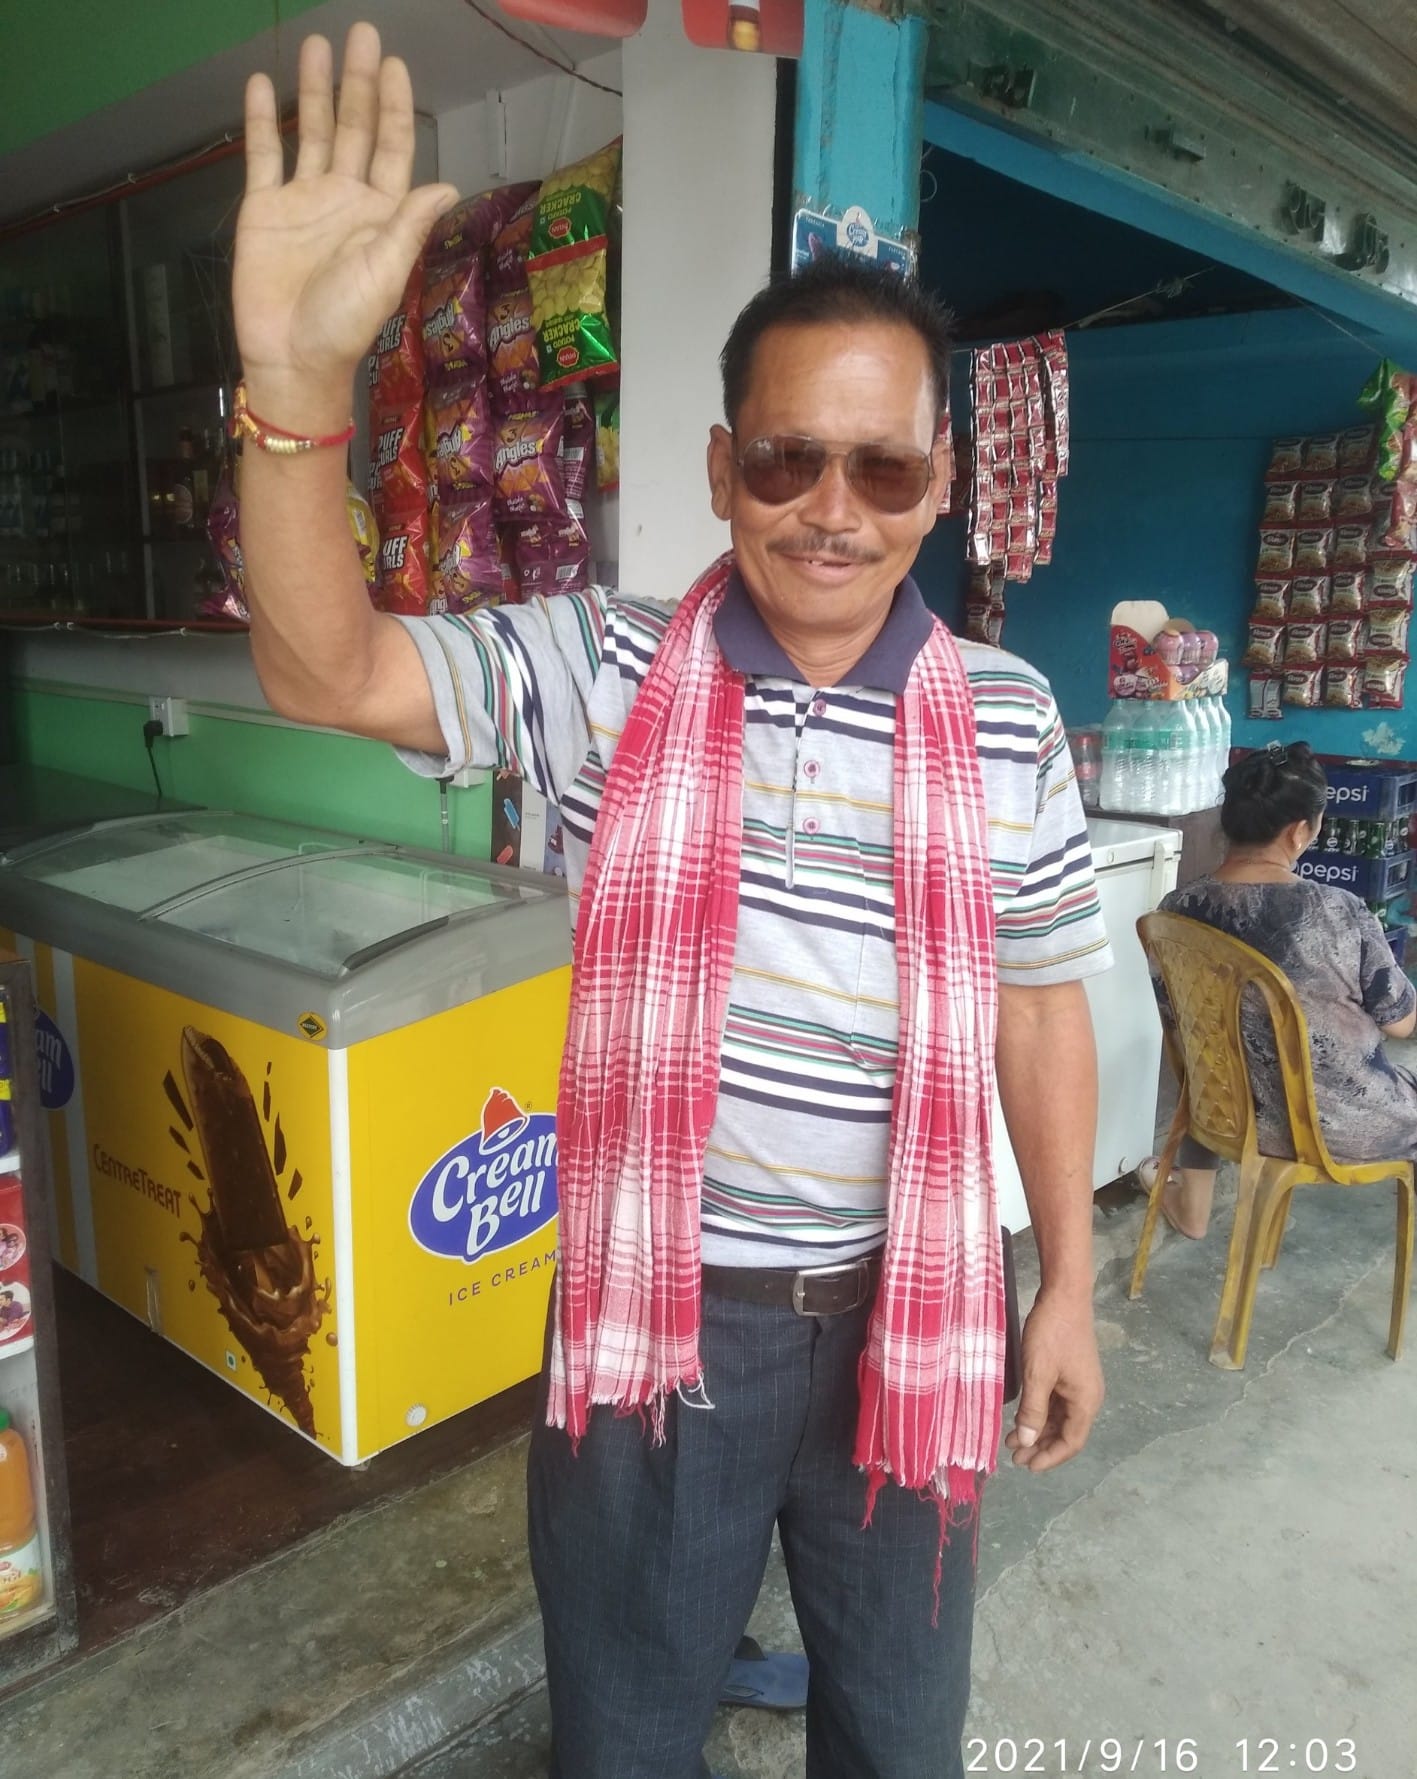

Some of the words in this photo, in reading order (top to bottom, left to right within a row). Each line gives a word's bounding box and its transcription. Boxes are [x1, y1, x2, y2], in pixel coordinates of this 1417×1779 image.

[539, 191, 582, 216] CRACKER
[488, 317, 531, 348] Angles
[543, 319, 582, 342] CRACKER
[495, 441, 536, 470] Angles
[383, 536, 408, 557] UFF
[1326, 785, 1369, 804] epsi
[1300, 862, 1358, 883] pepsi
[432, 1132, 558, 1222] Cream
[466, 1170, 546, 1256] Bell
[449, 1281, 482, 1306] ICE
[491, 1250, 557, 1287] CREAM
